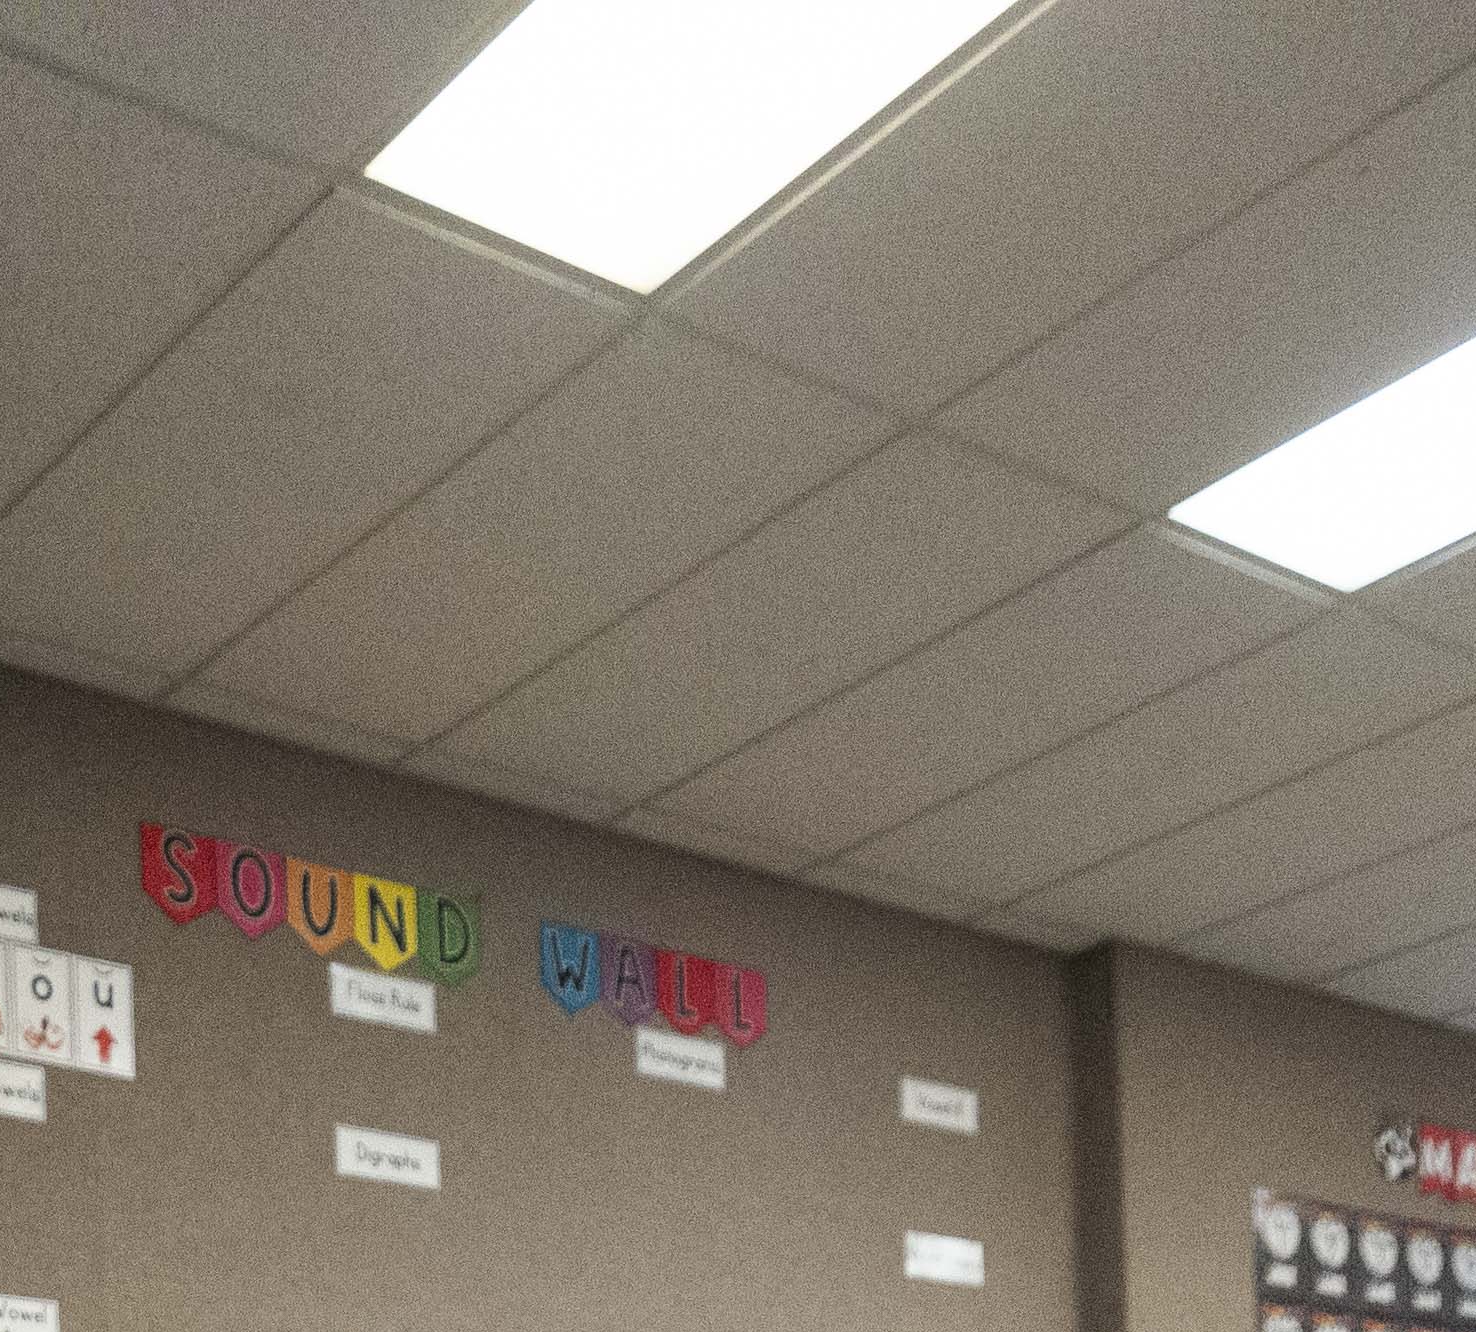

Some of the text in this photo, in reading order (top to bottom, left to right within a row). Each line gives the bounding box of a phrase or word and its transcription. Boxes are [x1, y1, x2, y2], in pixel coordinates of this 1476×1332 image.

[160, 830, 753, 1032] SOUND WALL
[30, 974, 53, 1001] o
[92, 980, 115, 1009] u
